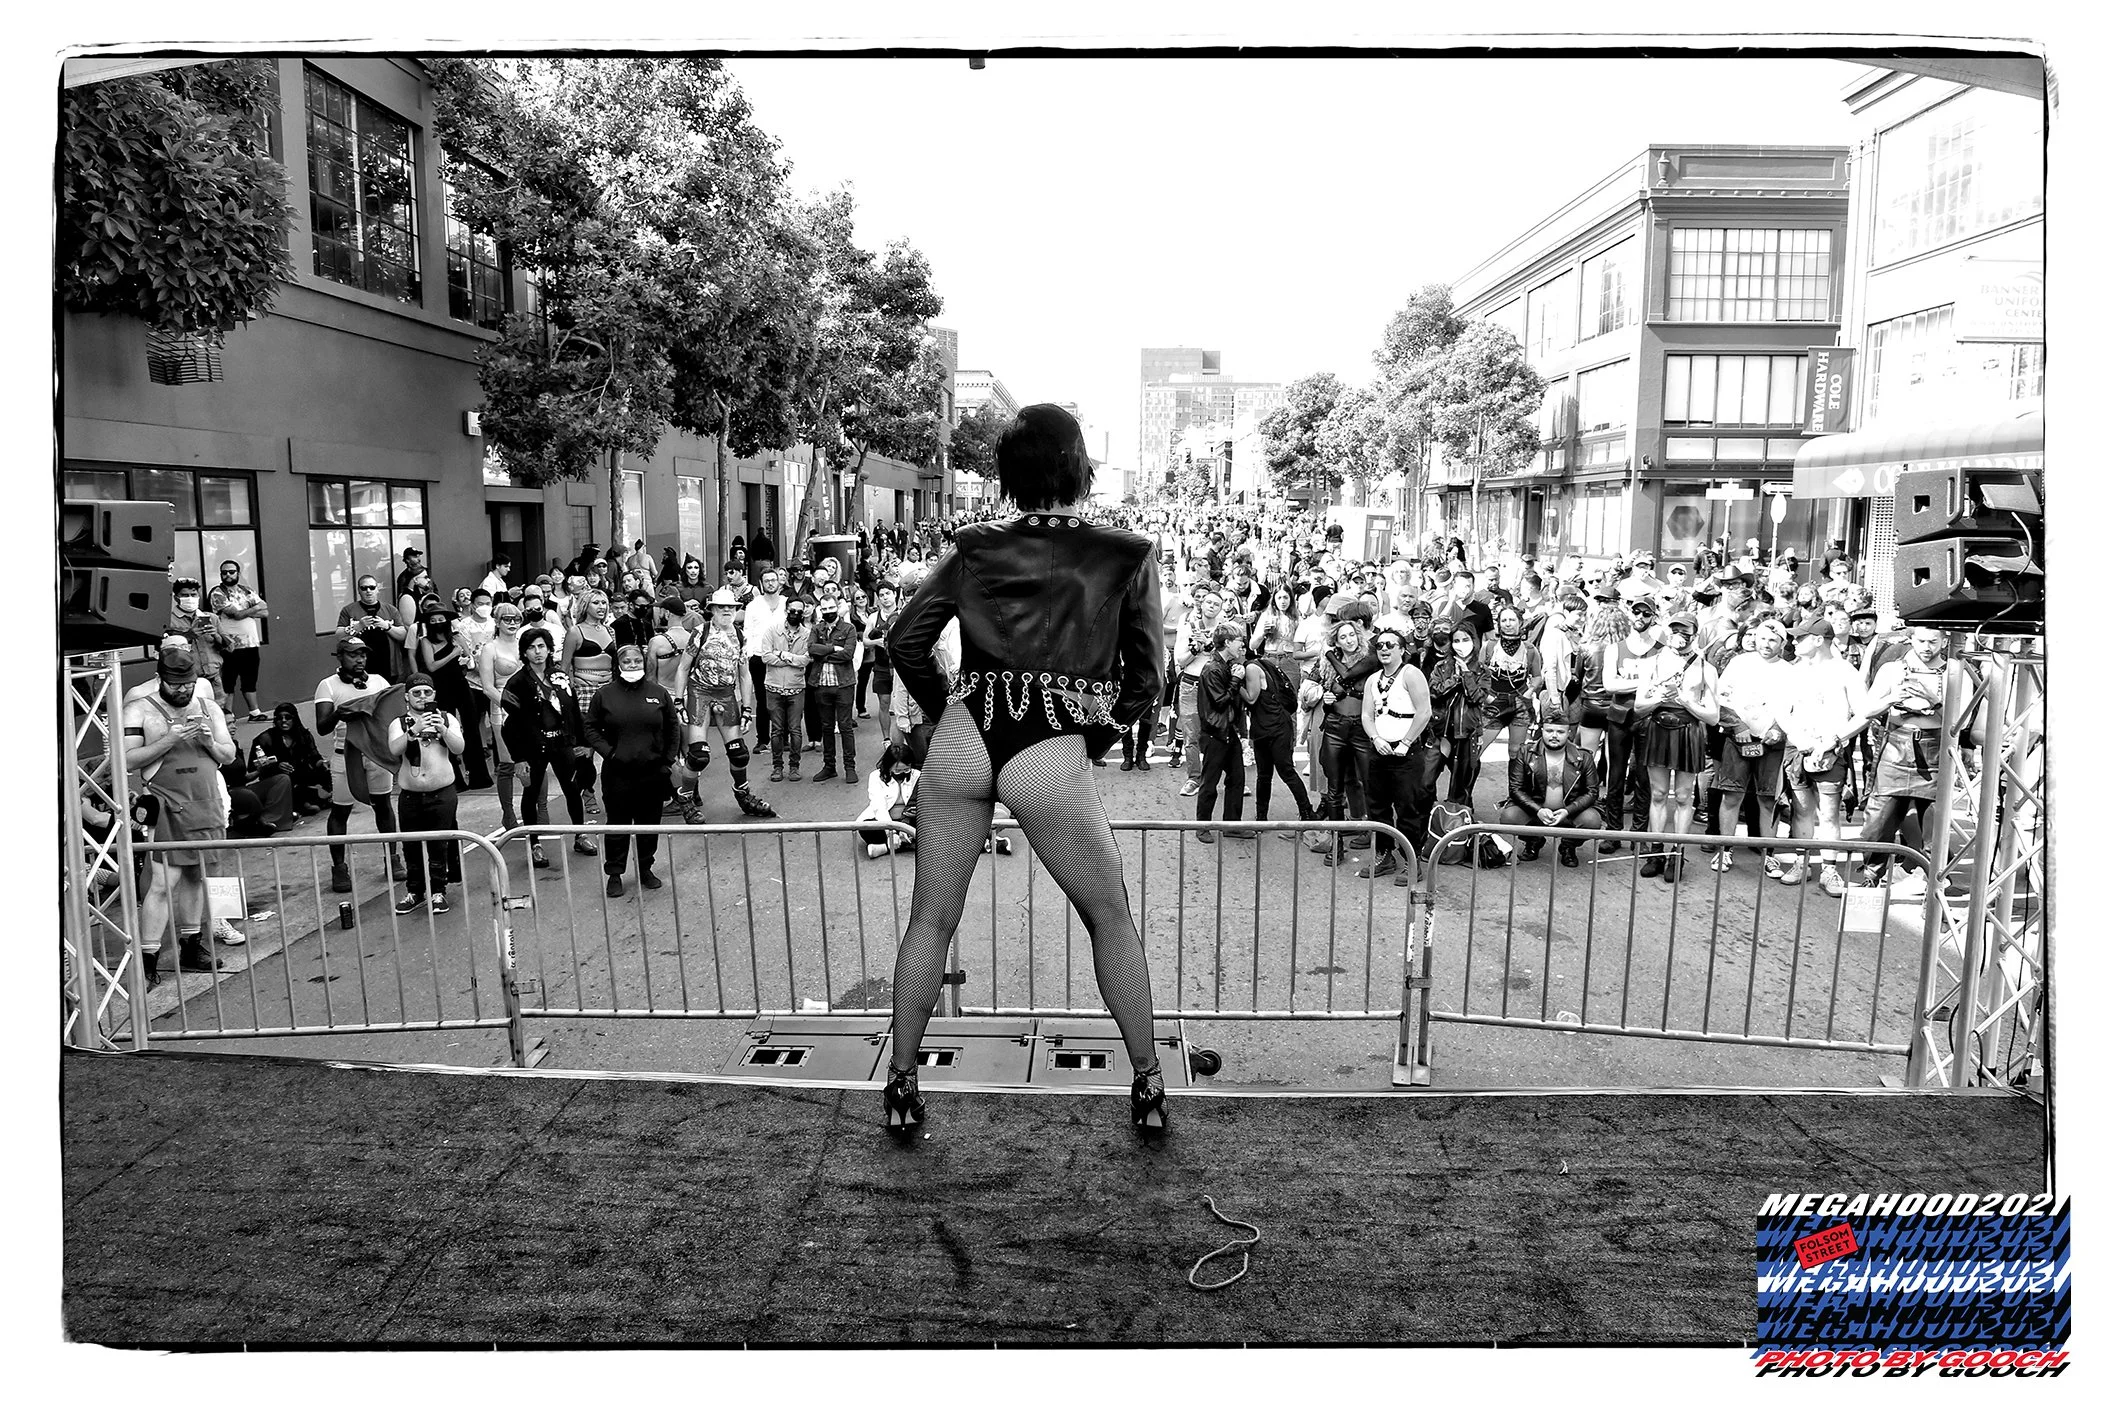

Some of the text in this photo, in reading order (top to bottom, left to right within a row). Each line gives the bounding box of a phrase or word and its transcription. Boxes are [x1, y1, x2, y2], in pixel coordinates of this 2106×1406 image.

[1980, 284, 2040, 295] BANNER
[1994, 297, 2043, 307] UNIFO
[1812, 352, 1829, 432] HARDWARE
[1828, 374, 1842, 410] COLE
